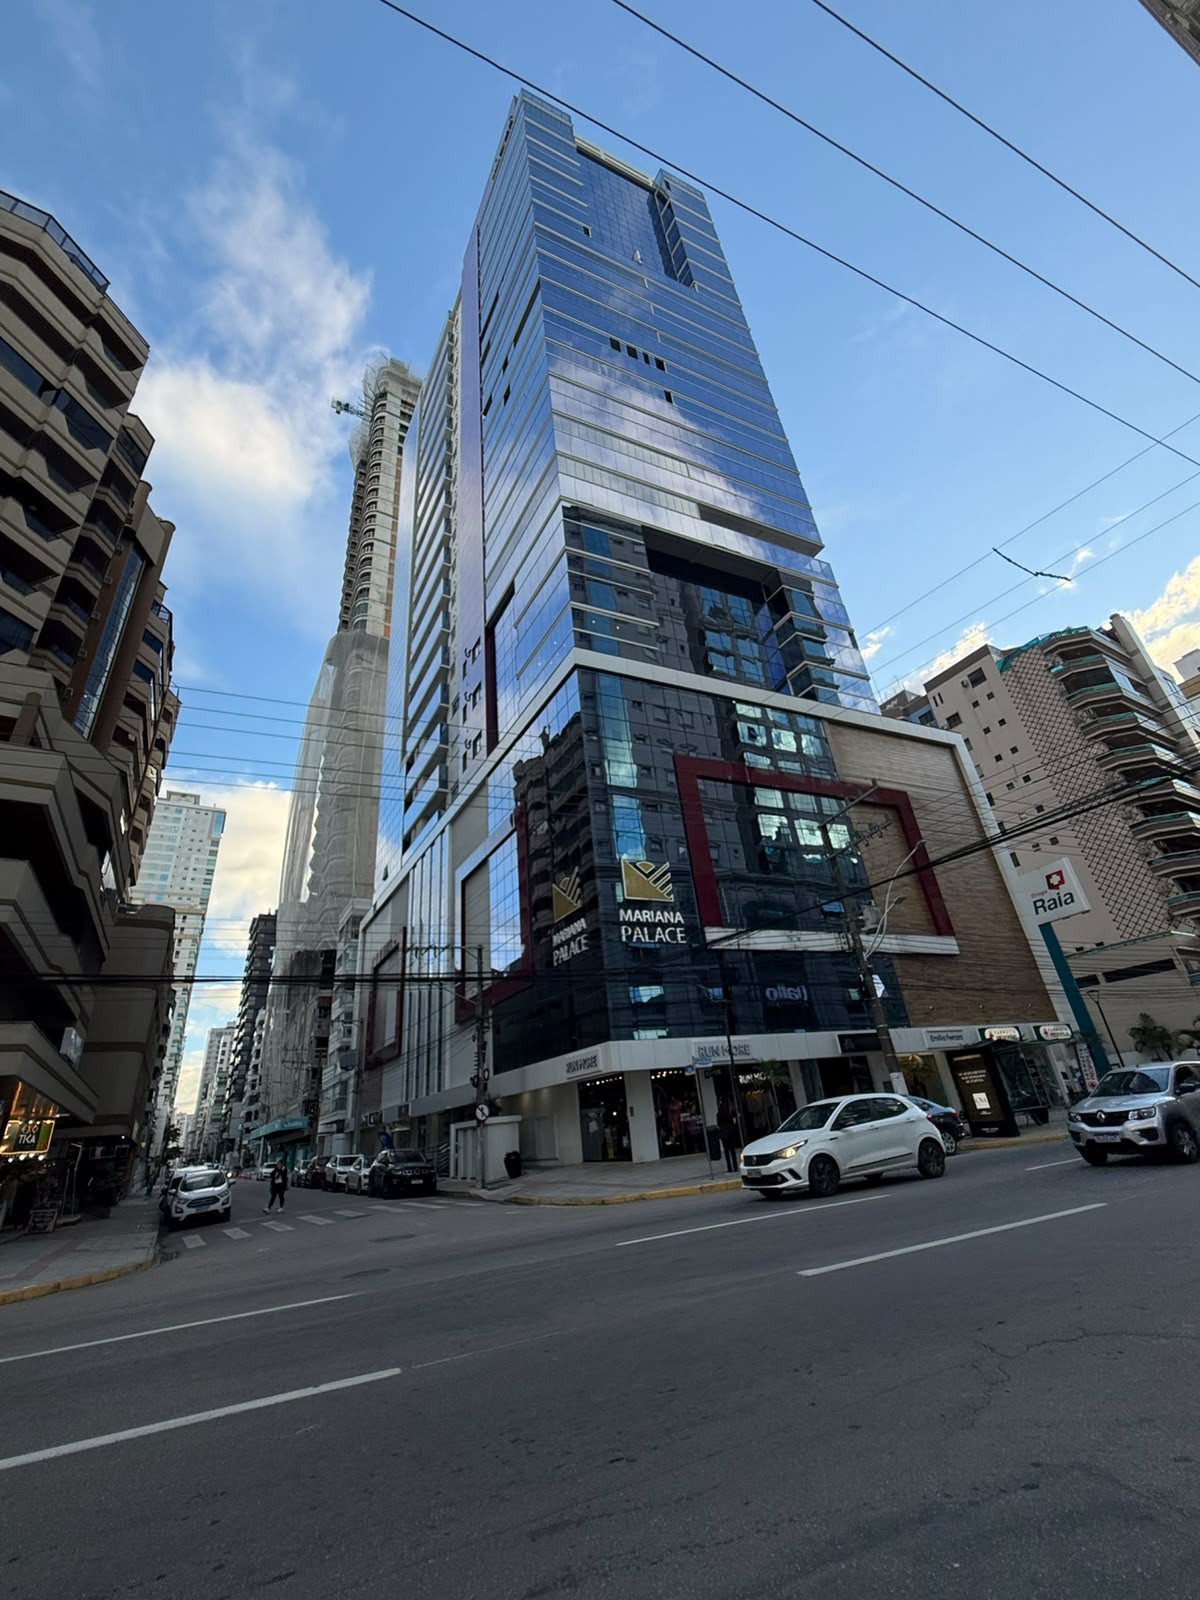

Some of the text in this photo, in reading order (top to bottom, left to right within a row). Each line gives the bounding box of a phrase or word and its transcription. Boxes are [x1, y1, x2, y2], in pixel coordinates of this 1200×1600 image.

[1033, 891, 1075, 915] Raia
[619, 908, 685, 924] MARIANA
[552, 917, 587, 947] MARIANA
[621, 925, 687, 944] PALACE
[552, 934, 589, 966] PALACE
[697, 1044, 751, 1057] RUN MORE
